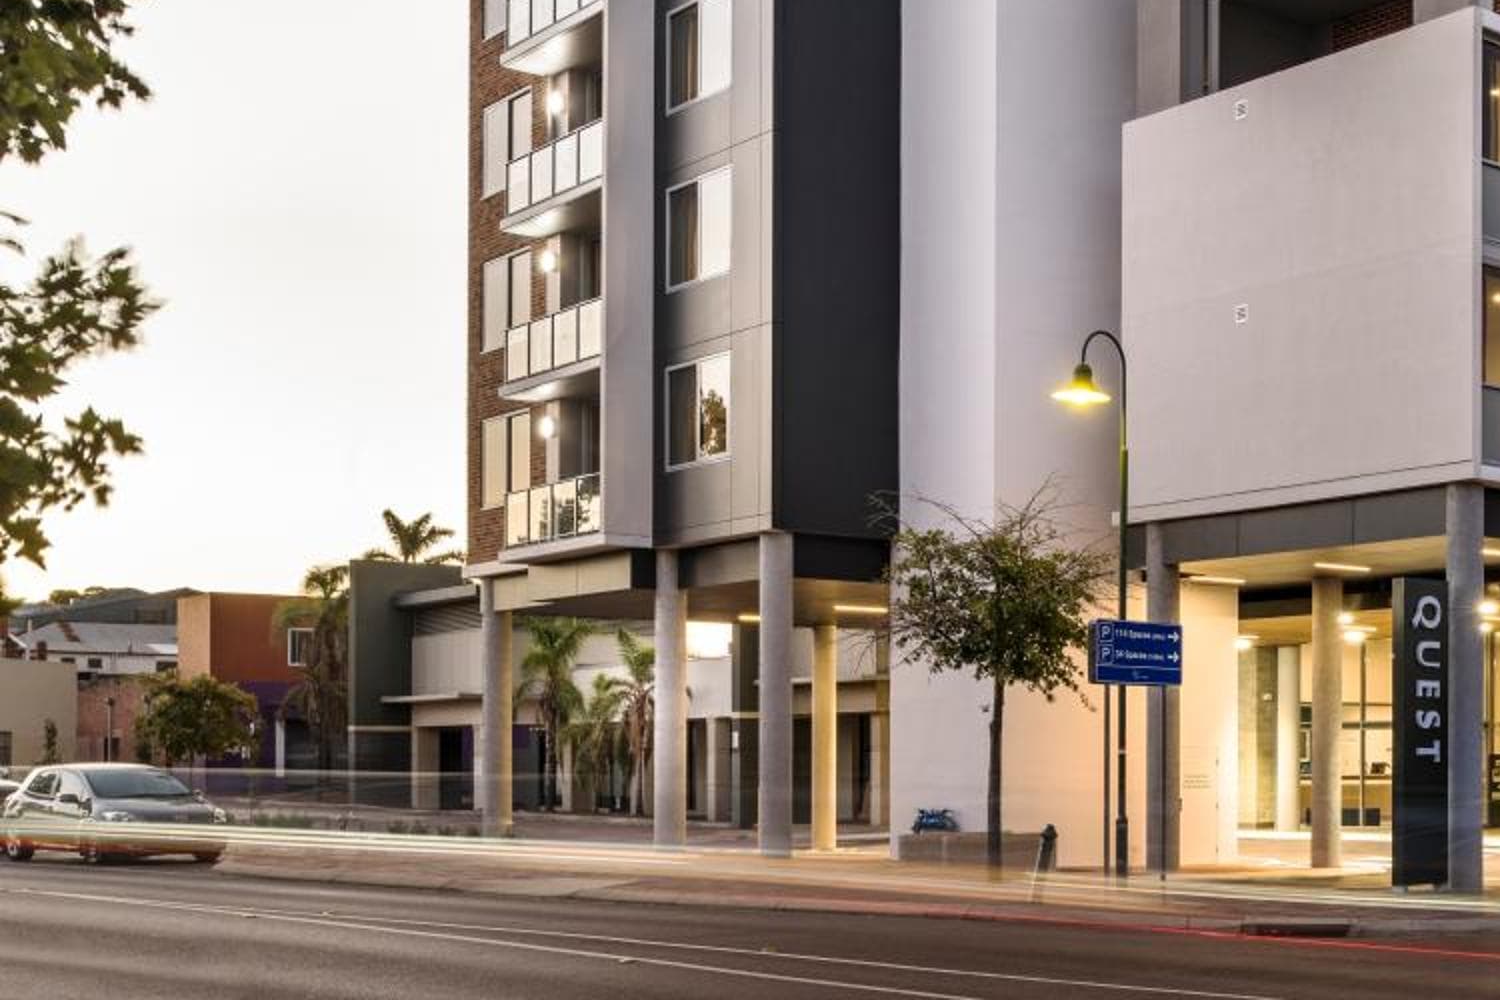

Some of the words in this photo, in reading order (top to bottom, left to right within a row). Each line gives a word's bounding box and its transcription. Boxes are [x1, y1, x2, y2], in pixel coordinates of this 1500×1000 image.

[1101, 625, 1111, 638] P
[1101, 647, 1111, 659] P
[1412, 595, 1442, 763] QUEST
